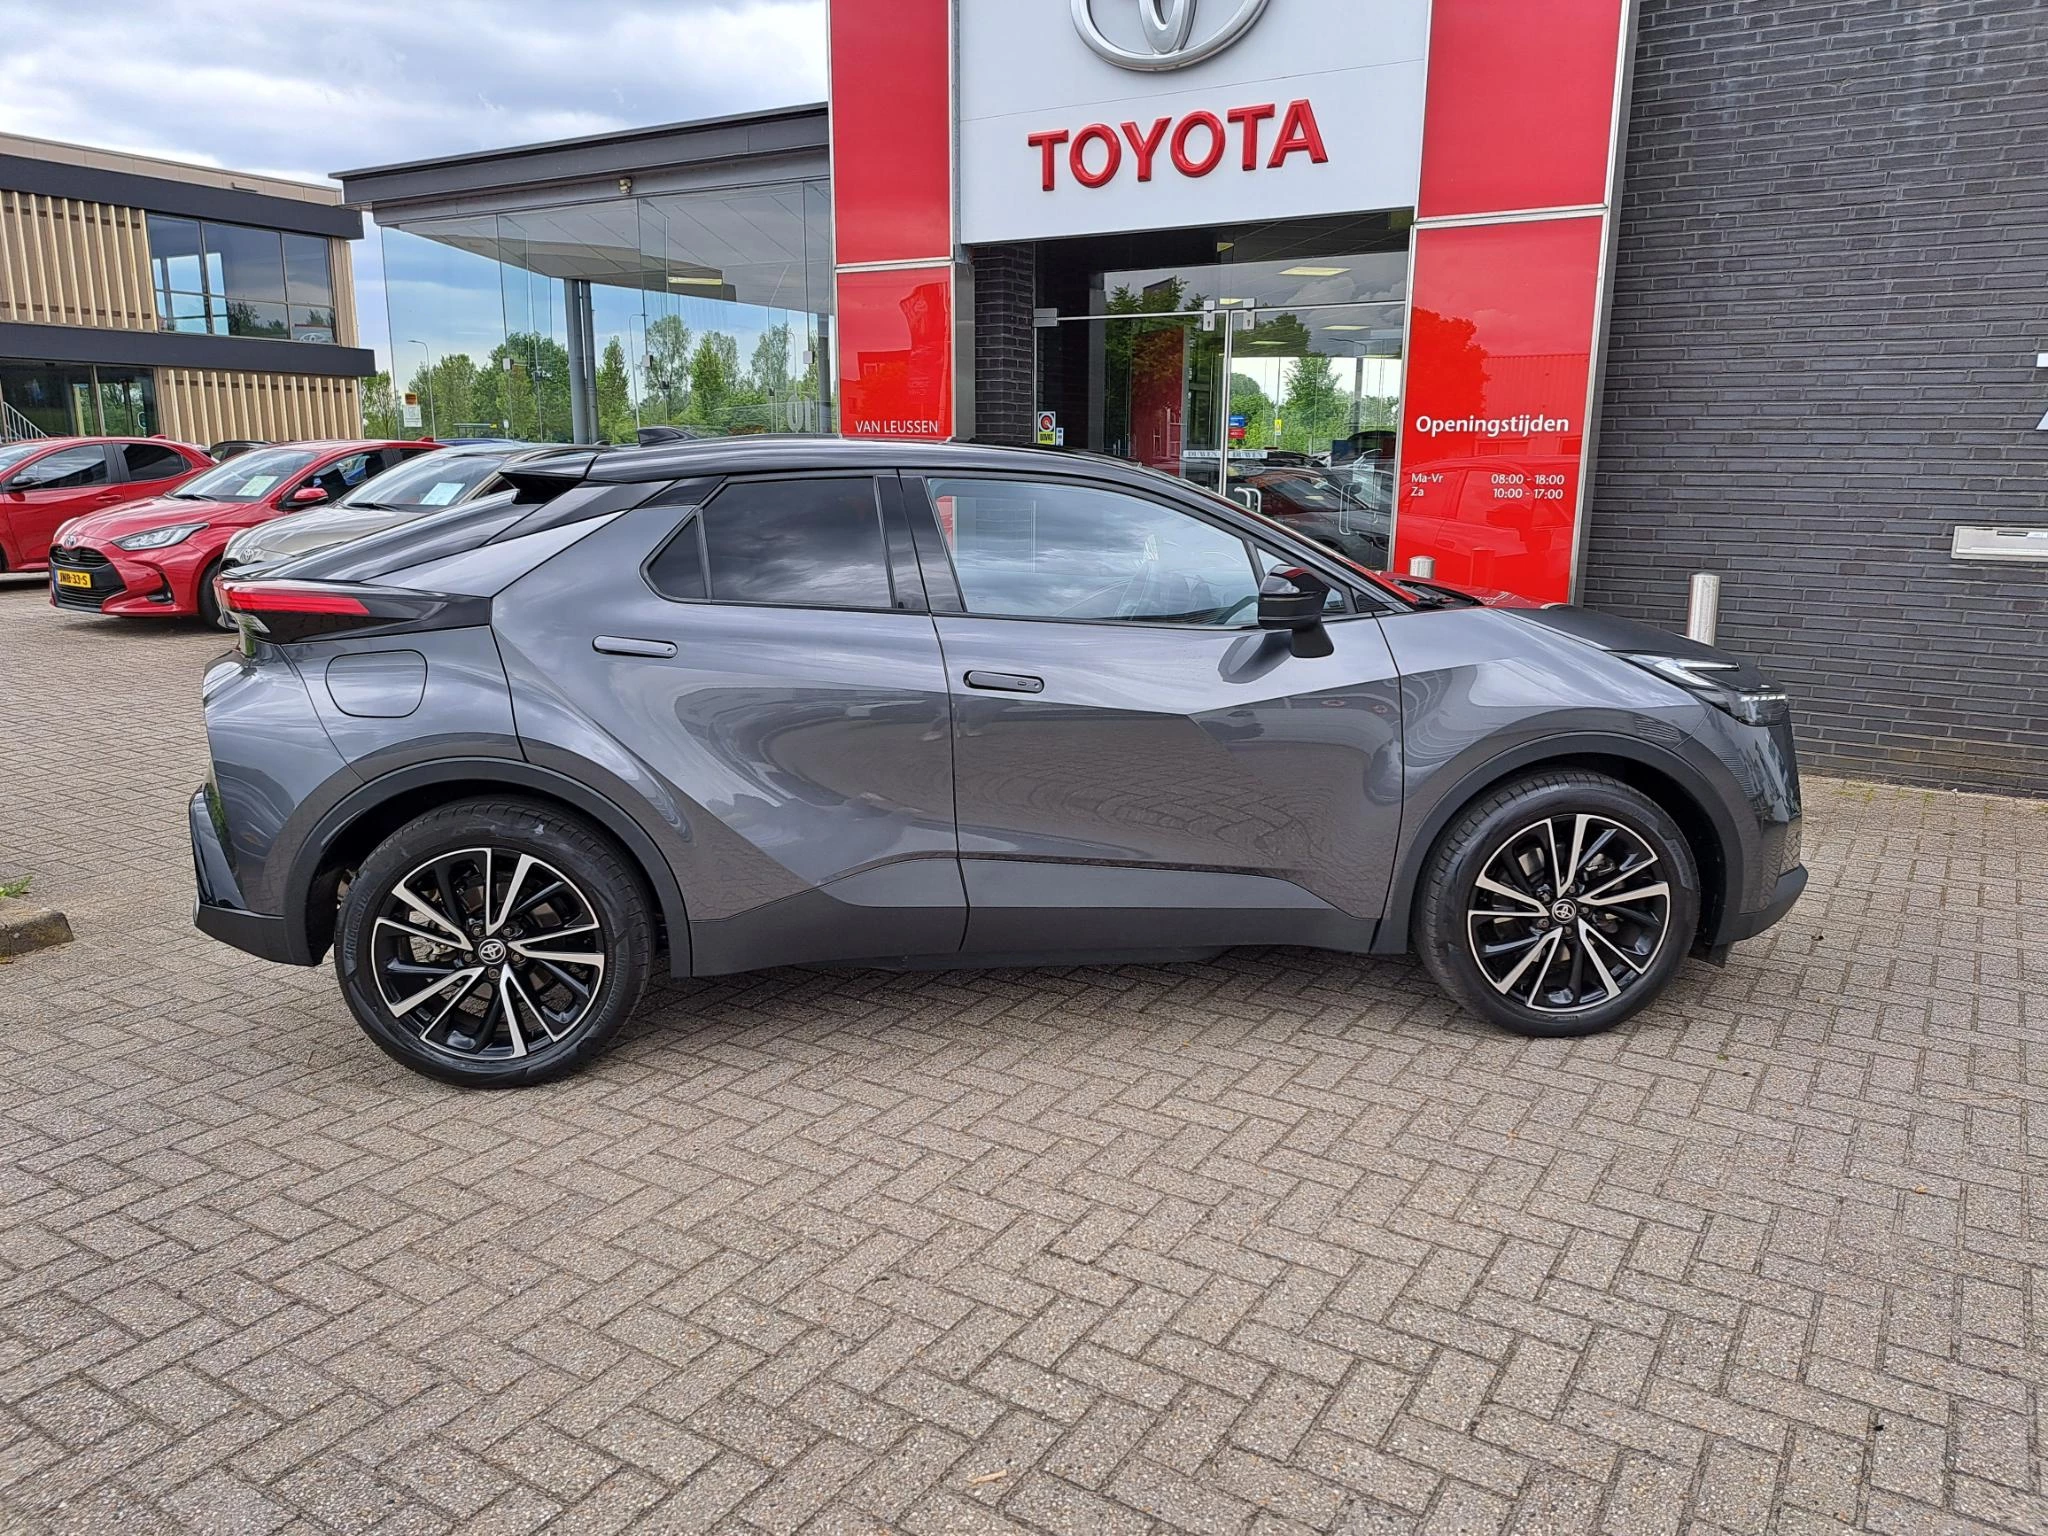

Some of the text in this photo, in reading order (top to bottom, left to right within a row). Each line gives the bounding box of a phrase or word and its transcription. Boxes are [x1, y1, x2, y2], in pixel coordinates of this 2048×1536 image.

[1027, 98, 1329, 192] TOYOTA
[855, 420, 939, 434] VAN LEUSSEN
[1415, 414, 1570, 438] Openingstijden
[1410, 472, 1444, 483] Ma-Vr
[1490, 474, 1524, 485] 08:00
[1535, 474, 1565, 485] 18:00
[1410, 486, 1425, 497] Za
[1493, 488, 1523, 499] 10:00
[1533, 488, 1564, 499] 17:00
